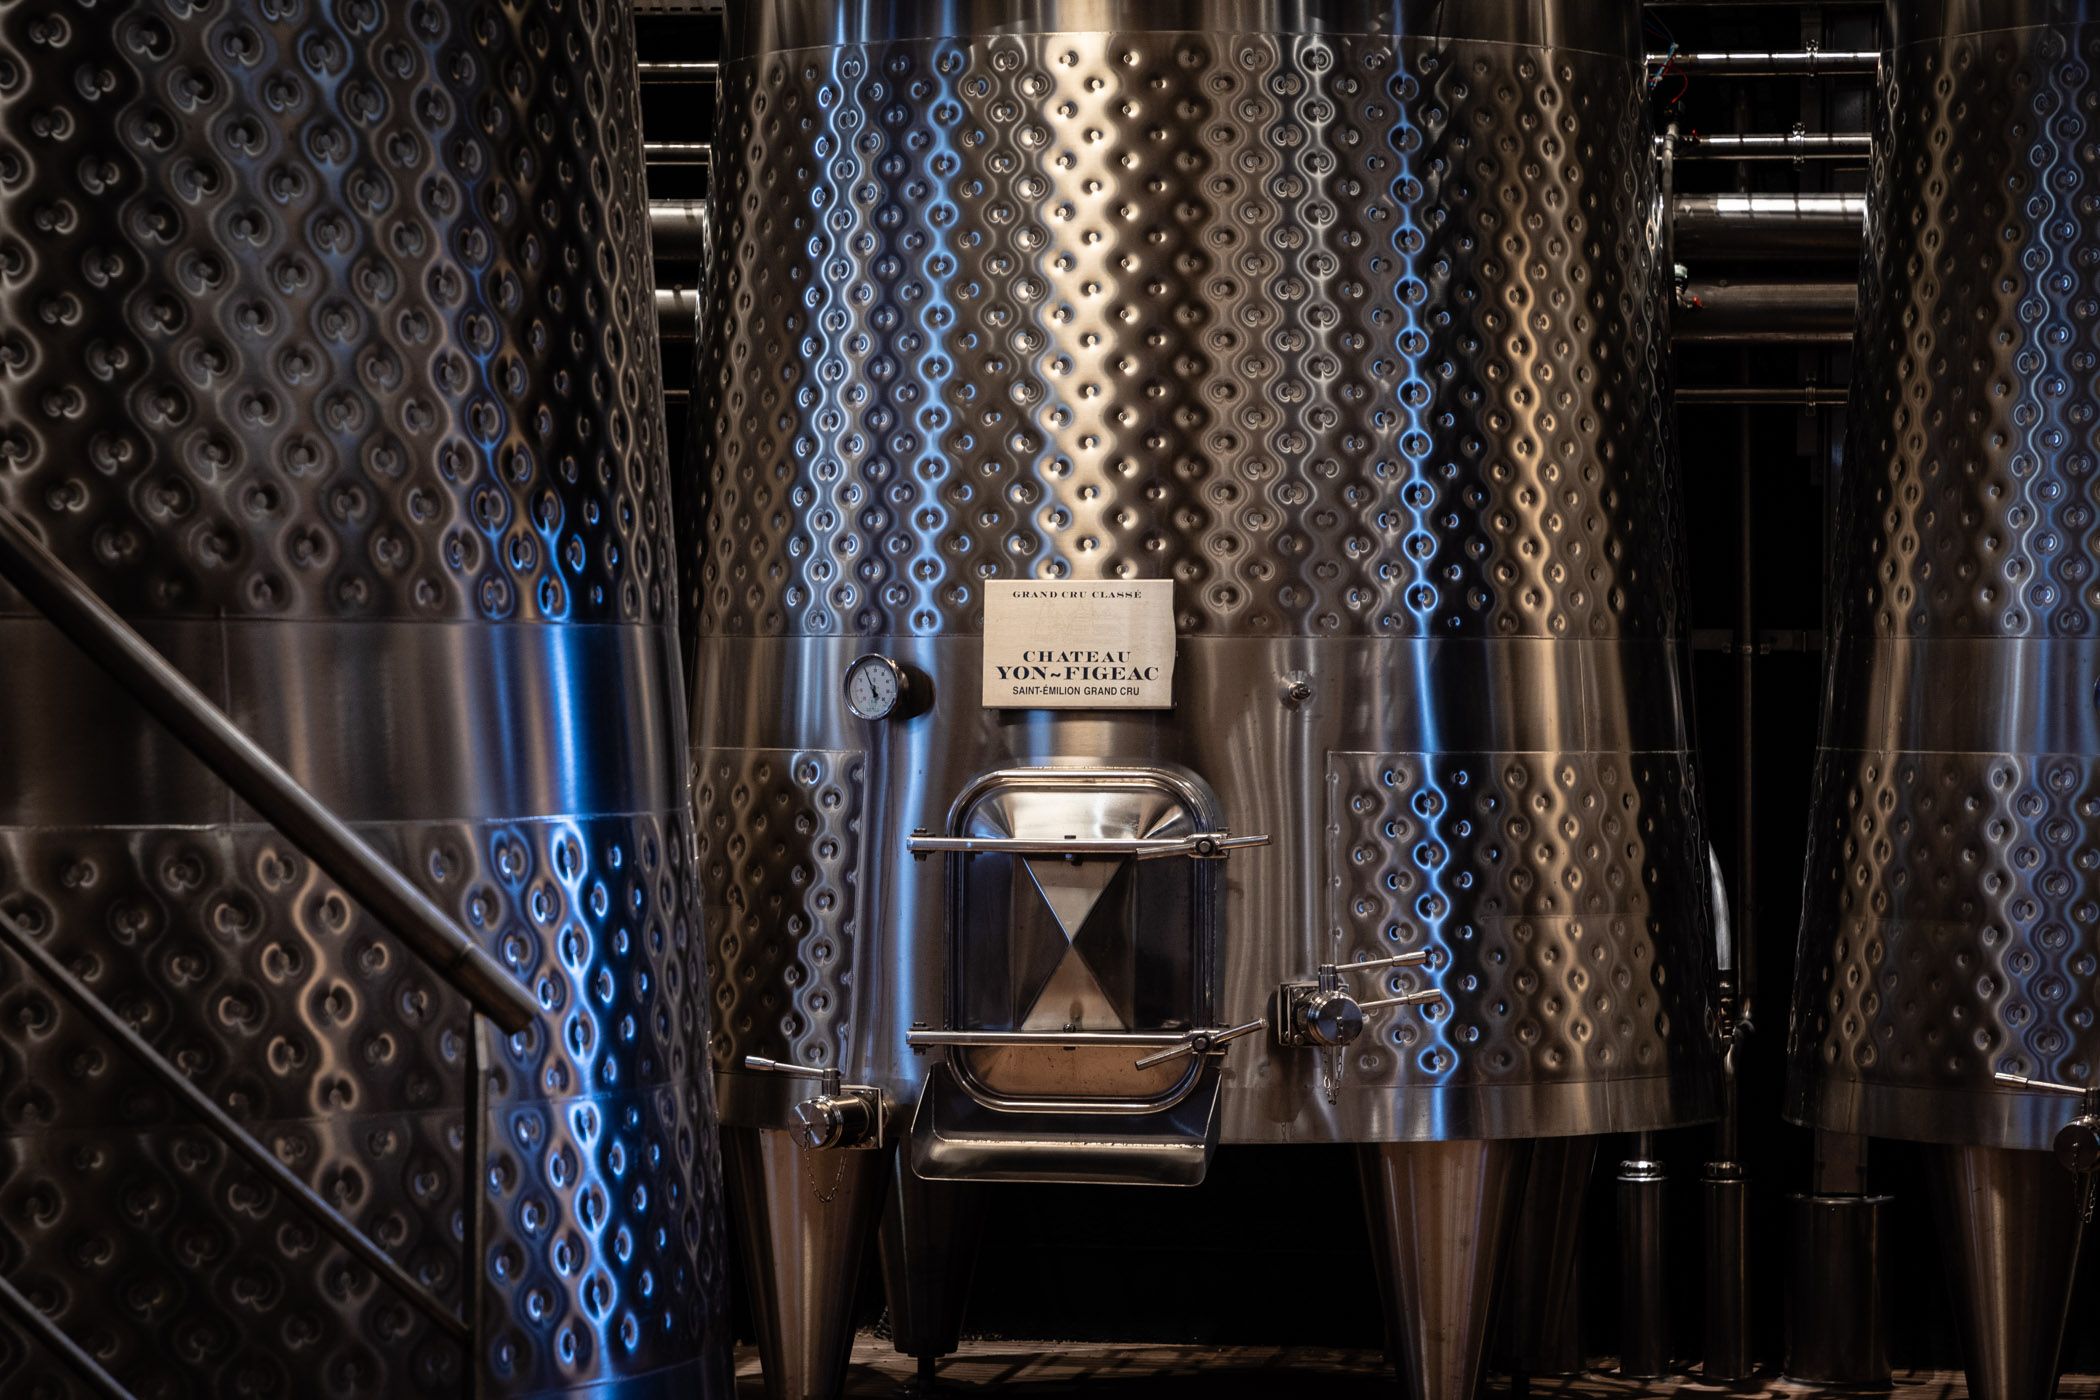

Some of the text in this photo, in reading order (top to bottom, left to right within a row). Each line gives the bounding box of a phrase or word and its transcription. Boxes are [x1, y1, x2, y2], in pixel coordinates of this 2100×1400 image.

[1092, 589, 1142, 598] CLASSÉ
[1023, 651, 1131, 662] CHATEAU
[1012, 684, 1140, 695] SAINT-ÉMILION GRAND CRU
